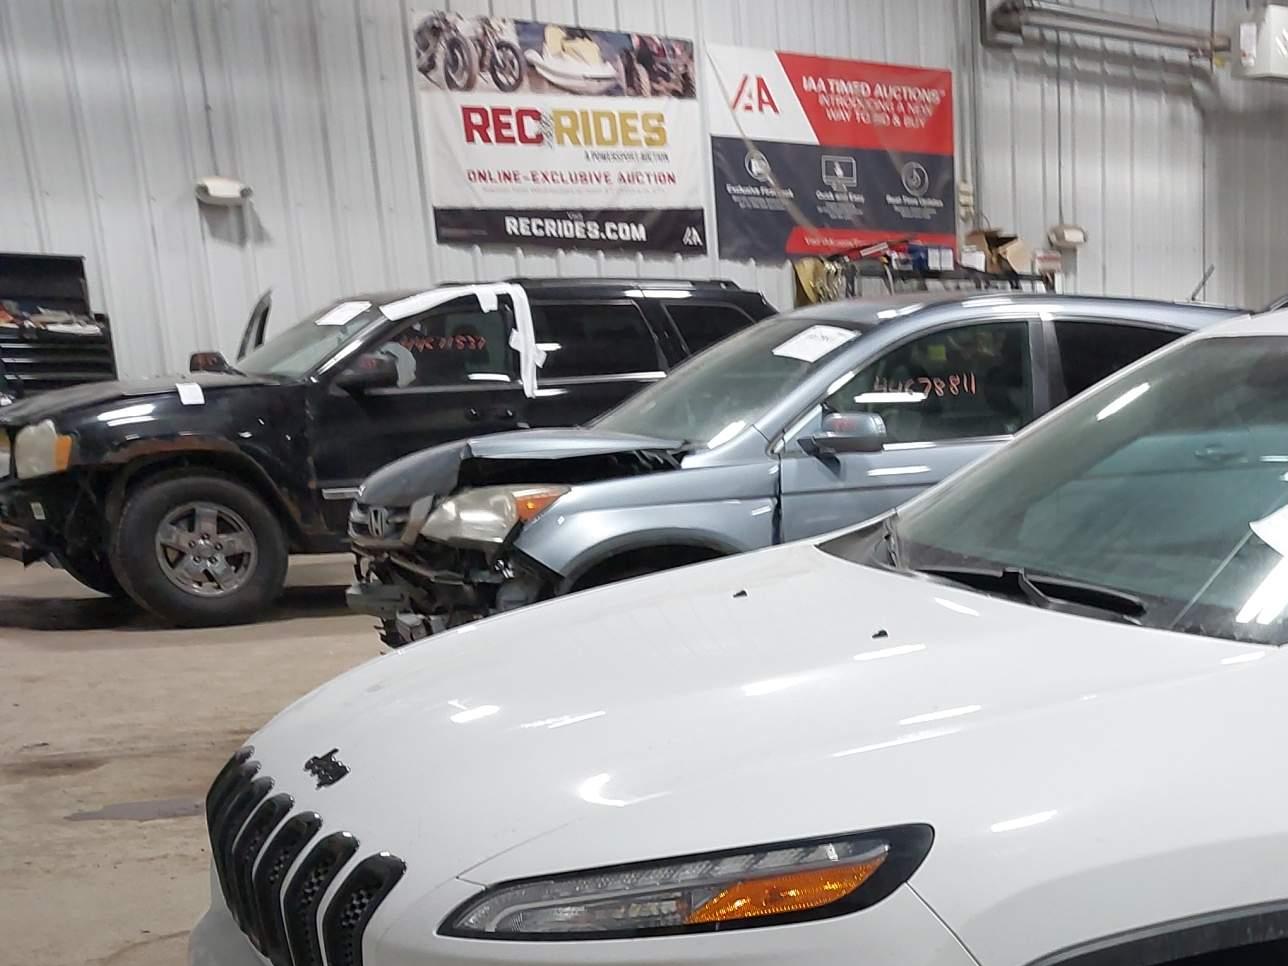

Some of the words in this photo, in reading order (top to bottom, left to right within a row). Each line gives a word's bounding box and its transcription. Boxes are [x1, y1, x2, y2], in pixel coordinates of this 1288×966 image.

[461, 105, 545, 146] REC
[551, 108, 669, 147] RIDES
[617, 170, 678, 186] AUCTION
[503, 215, 648, 242] RECRIDES.COM
